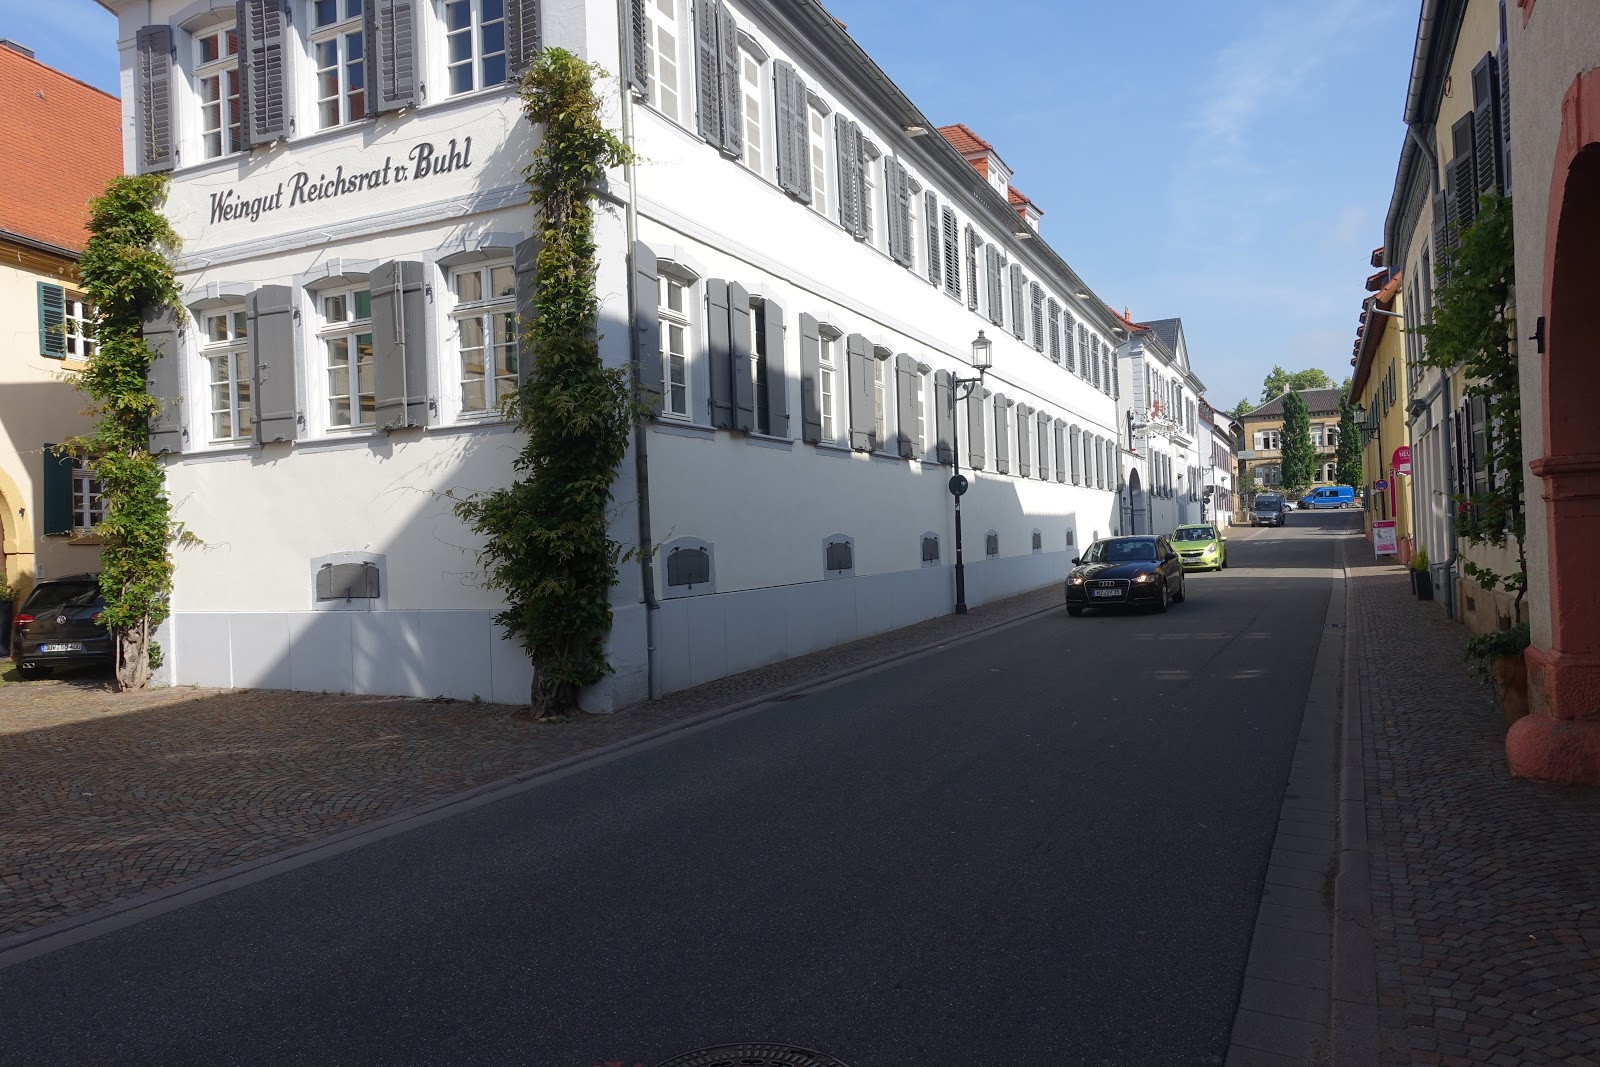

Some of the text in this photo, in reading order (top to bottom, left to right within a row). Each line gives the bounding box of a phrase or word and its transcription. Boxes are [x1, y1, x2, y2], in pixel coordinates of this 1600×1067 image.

[209, 136, 472, 225] Weingut Reichsrat v. Buhl
